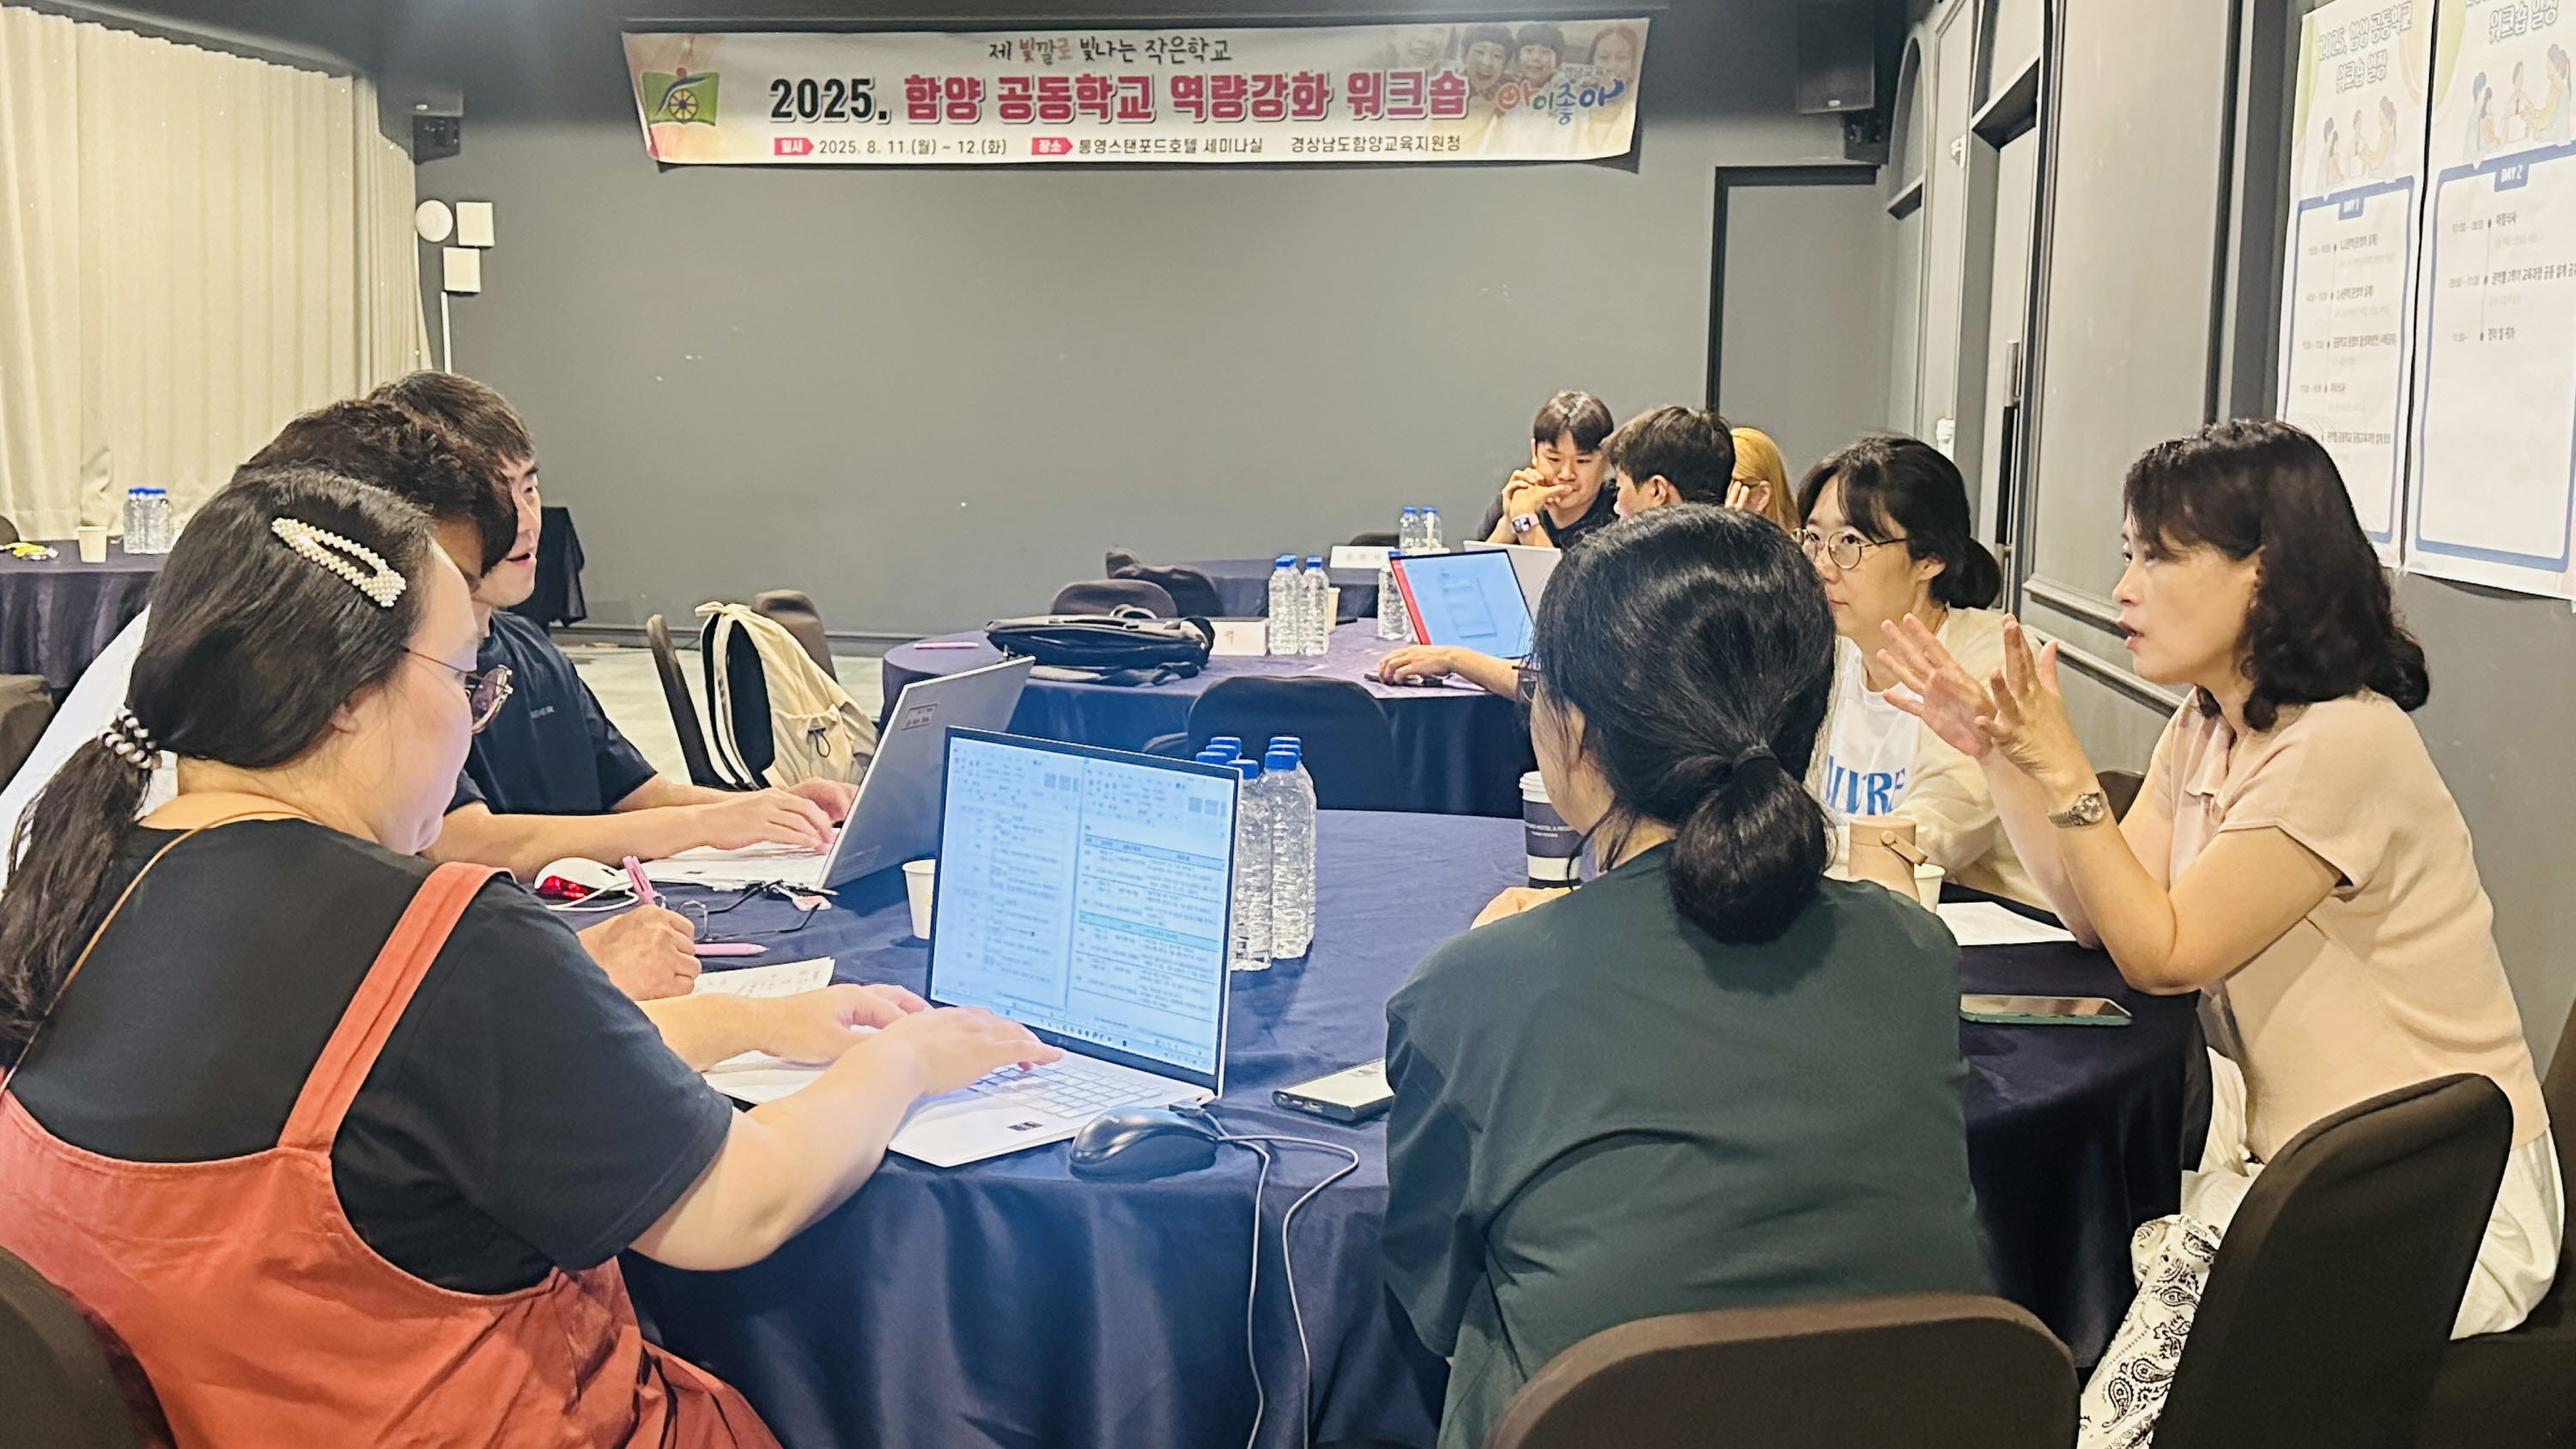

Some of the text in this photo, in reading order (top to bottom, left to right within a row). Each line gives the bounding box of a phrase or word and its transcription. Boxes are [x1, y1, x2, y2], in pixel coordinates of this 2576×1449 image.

[2371, 1, 2412, 44] 공동학교
[2489, 1, 2529, 44] 워크숍
[989, 35, 1232, 66] 제 빛깔로 빛나는 작은학교
[2336, 49, 2387, 94] 워크숍 일정
[769, 70, 1468, 122] 2025. 함양 공동학교 역량강화 워크숍
[1496, 79, 1625, 125] 아이좋아
[819, 140, 860, 155] 2025.
[867, 140, 882, 155] 8.
[889, 139, 937, 155] 11.(월)
[958, 139, 1006, 155] 12.(화)
[1038, 137, 1263, 155] 장소 통영스탠포드호텔 세미나실
[1291, 135, 1461, 153] 경상남도함양교육지원청
